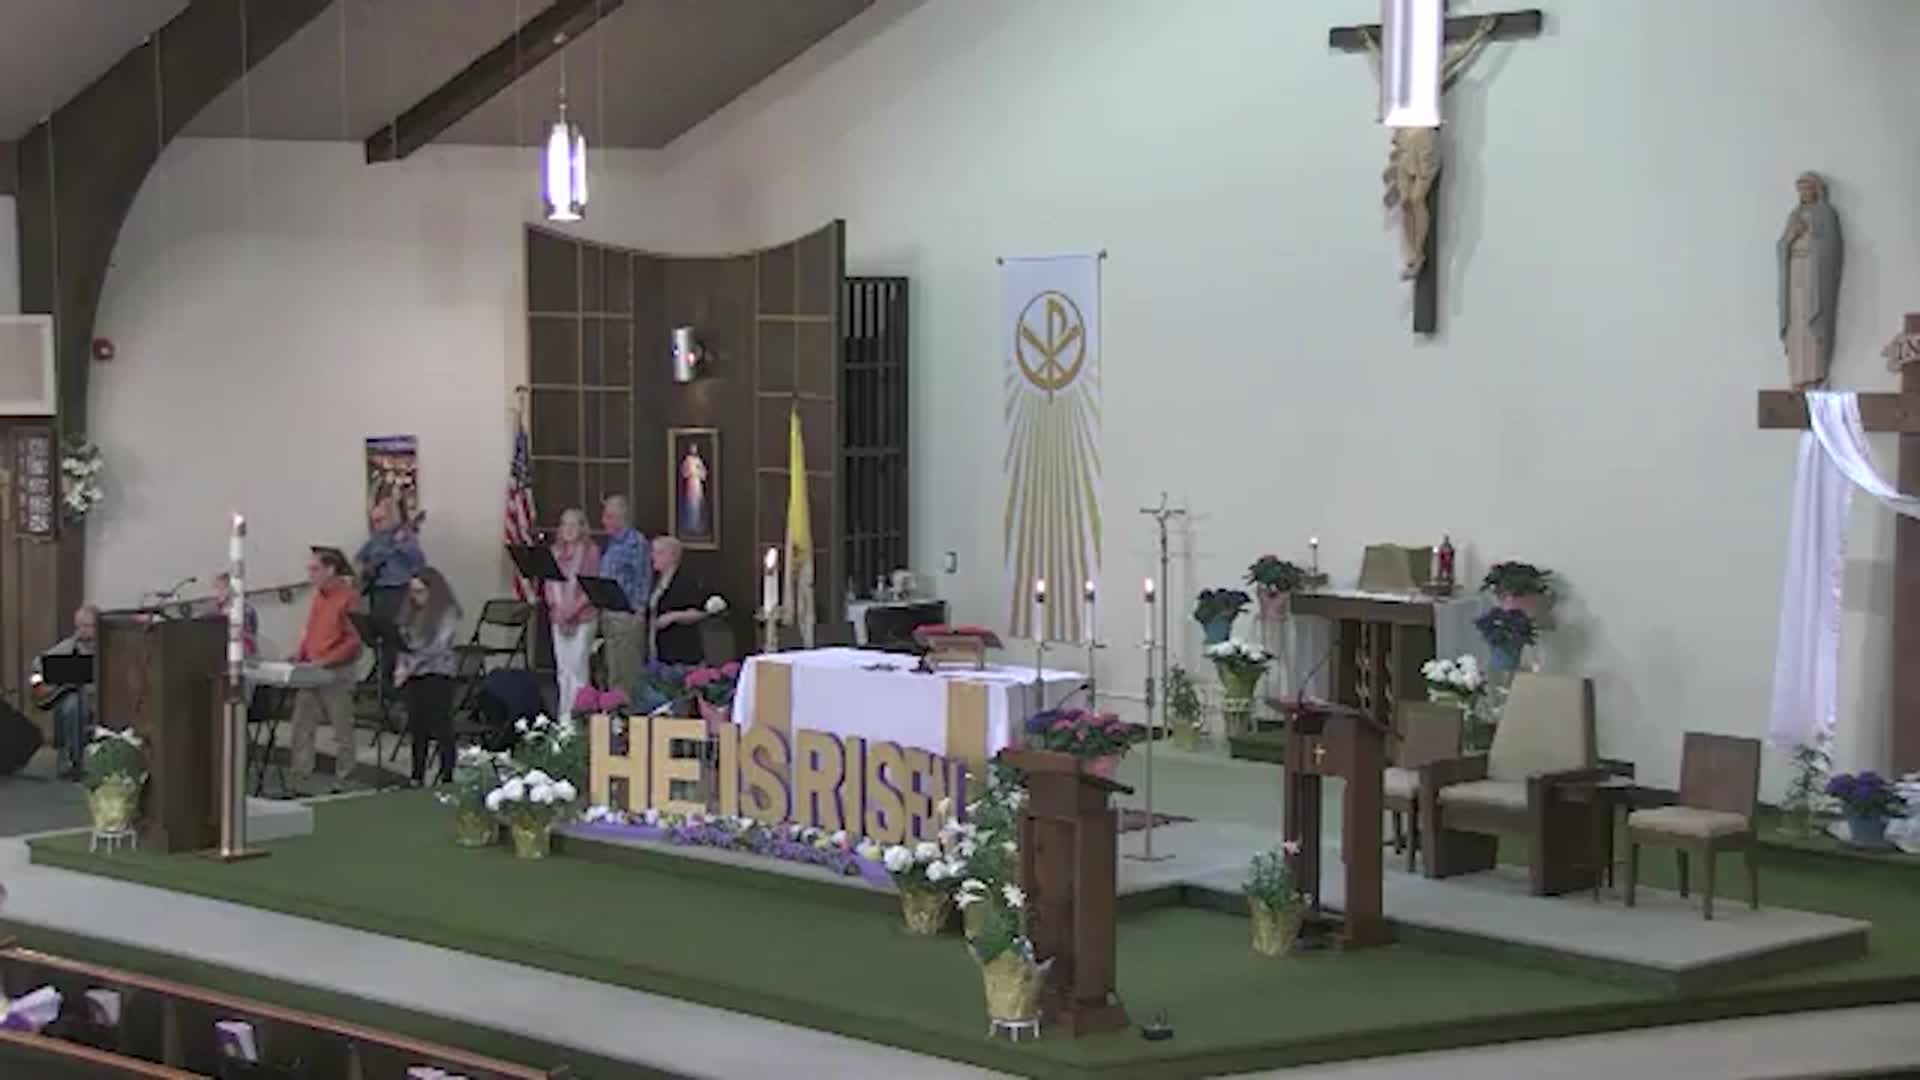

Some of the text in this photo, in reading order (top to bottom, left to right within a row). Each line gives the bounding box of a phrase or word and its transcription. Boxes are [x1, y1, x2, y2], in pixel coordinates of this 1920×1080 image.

[589, 714, 965, 844] HE IS RISEN
